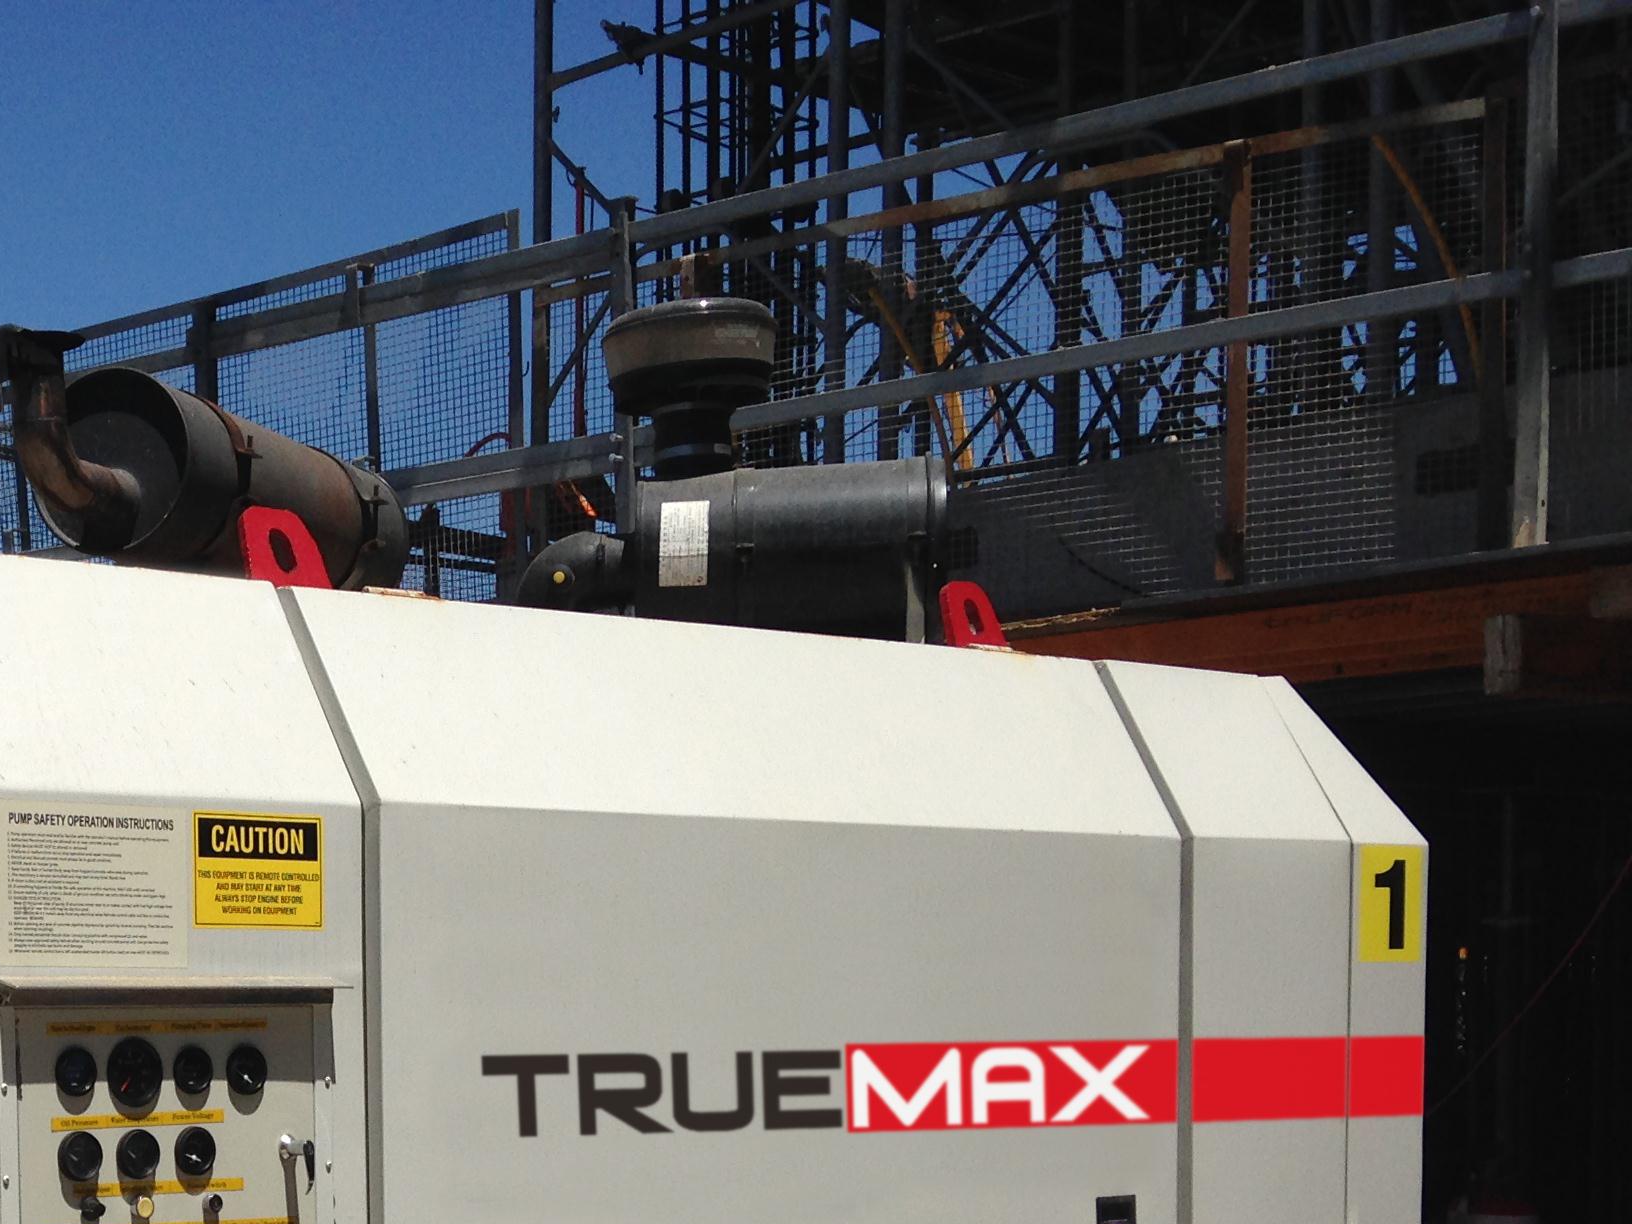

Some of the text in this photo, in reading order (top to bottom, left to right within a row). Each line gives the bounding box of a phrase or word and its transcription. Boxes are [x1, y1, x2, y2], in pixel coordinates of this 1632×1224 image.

[8, 812, 174, 831] PUMP SAFETY OPERATION INSTRUCTIONS
[211, 824, 304, 855] CAUTION
[197, 869, 320, 882] THIS EQUIPMENT IS REMOTE CONTROLLED
[216, 882, 302, 893] AND MAY START AT ANY TIME
[214, 894, 304, 905] ALWAYS STOP ENGINE BEFORE
[1374, 859, 1408, 951] 1
[221, 906, 297, 916] WORKING ON EQUIPMENT
[480, 1044, 1151, 1138] TRUEMAX
